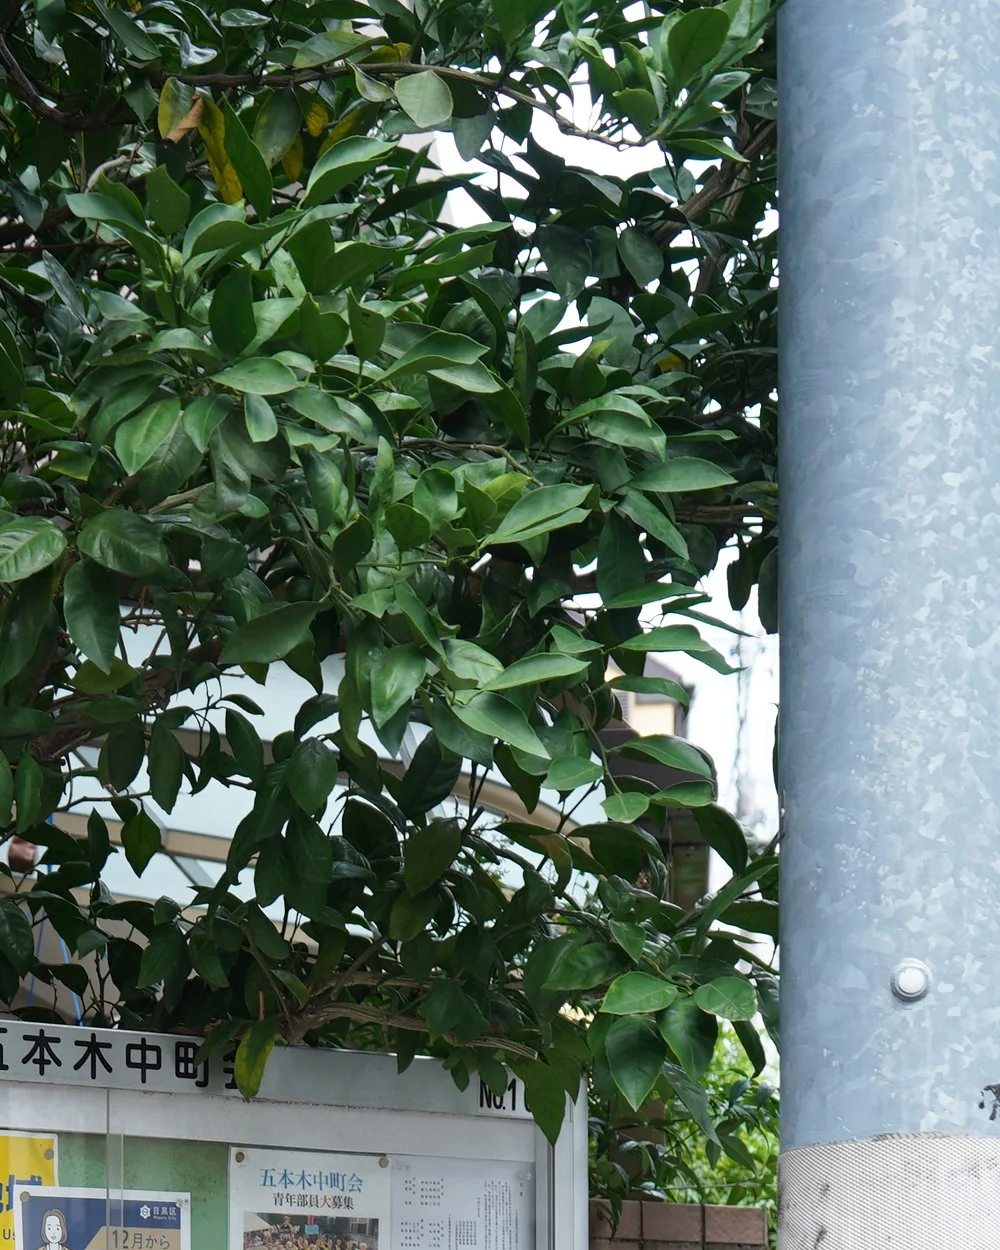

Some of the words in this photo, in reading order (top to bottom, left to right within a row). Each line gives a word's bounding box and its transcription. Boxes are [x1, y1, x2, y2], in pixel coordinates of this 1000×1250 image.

[260, 1168, 363, 1193] 五本木中町会
[273, 1192, 354, 1210] 青年部員大募集
[112, 1229, 171, 1250] 12月から
